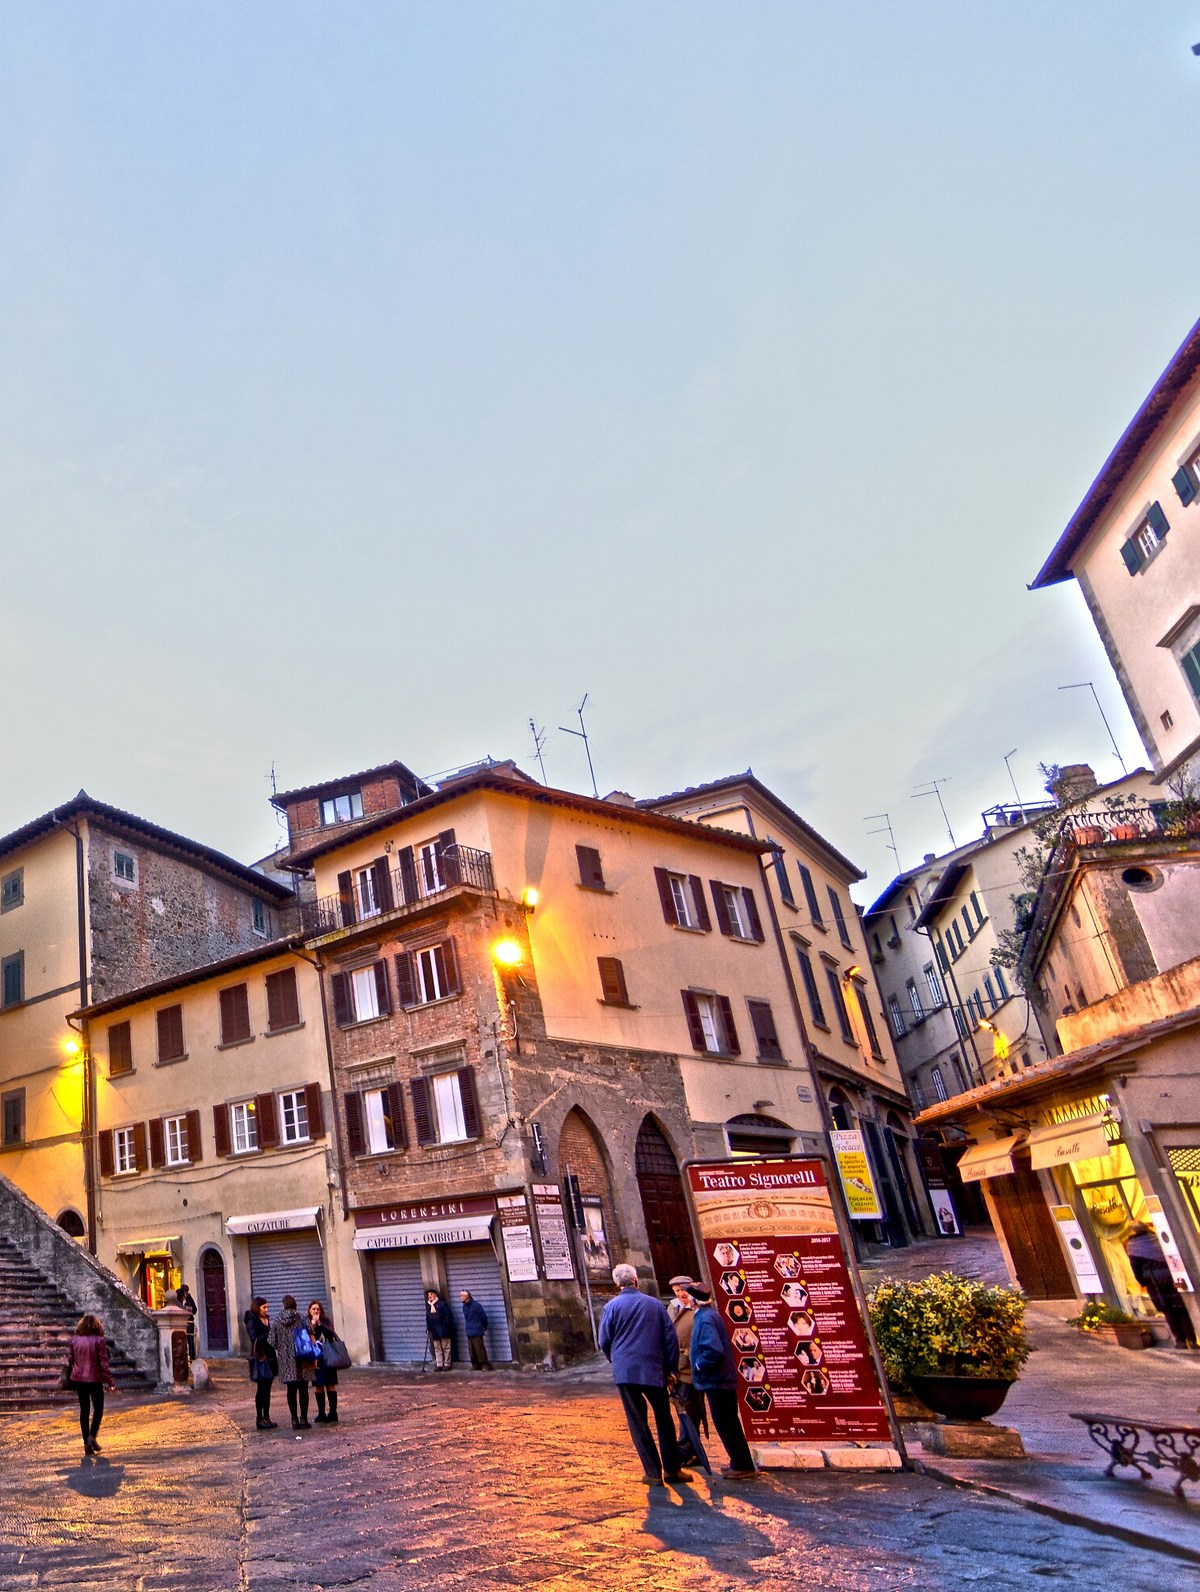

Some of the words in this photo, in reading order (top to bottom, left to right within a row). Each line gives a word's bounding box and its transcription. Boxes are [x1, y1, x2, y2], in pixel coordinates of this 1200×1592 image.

[700, 1175, 746, 1188] Teatro
[749, 1170, 816, 1188] Signorelli
[380, 1202, 464, 1222] LORENZINI
[247, 1219, 290, 1232] CALZATURE
[366, 1235, 408, 1248] CAPPELLI
[423, 1230, 473, 1243] OMBRELLI
